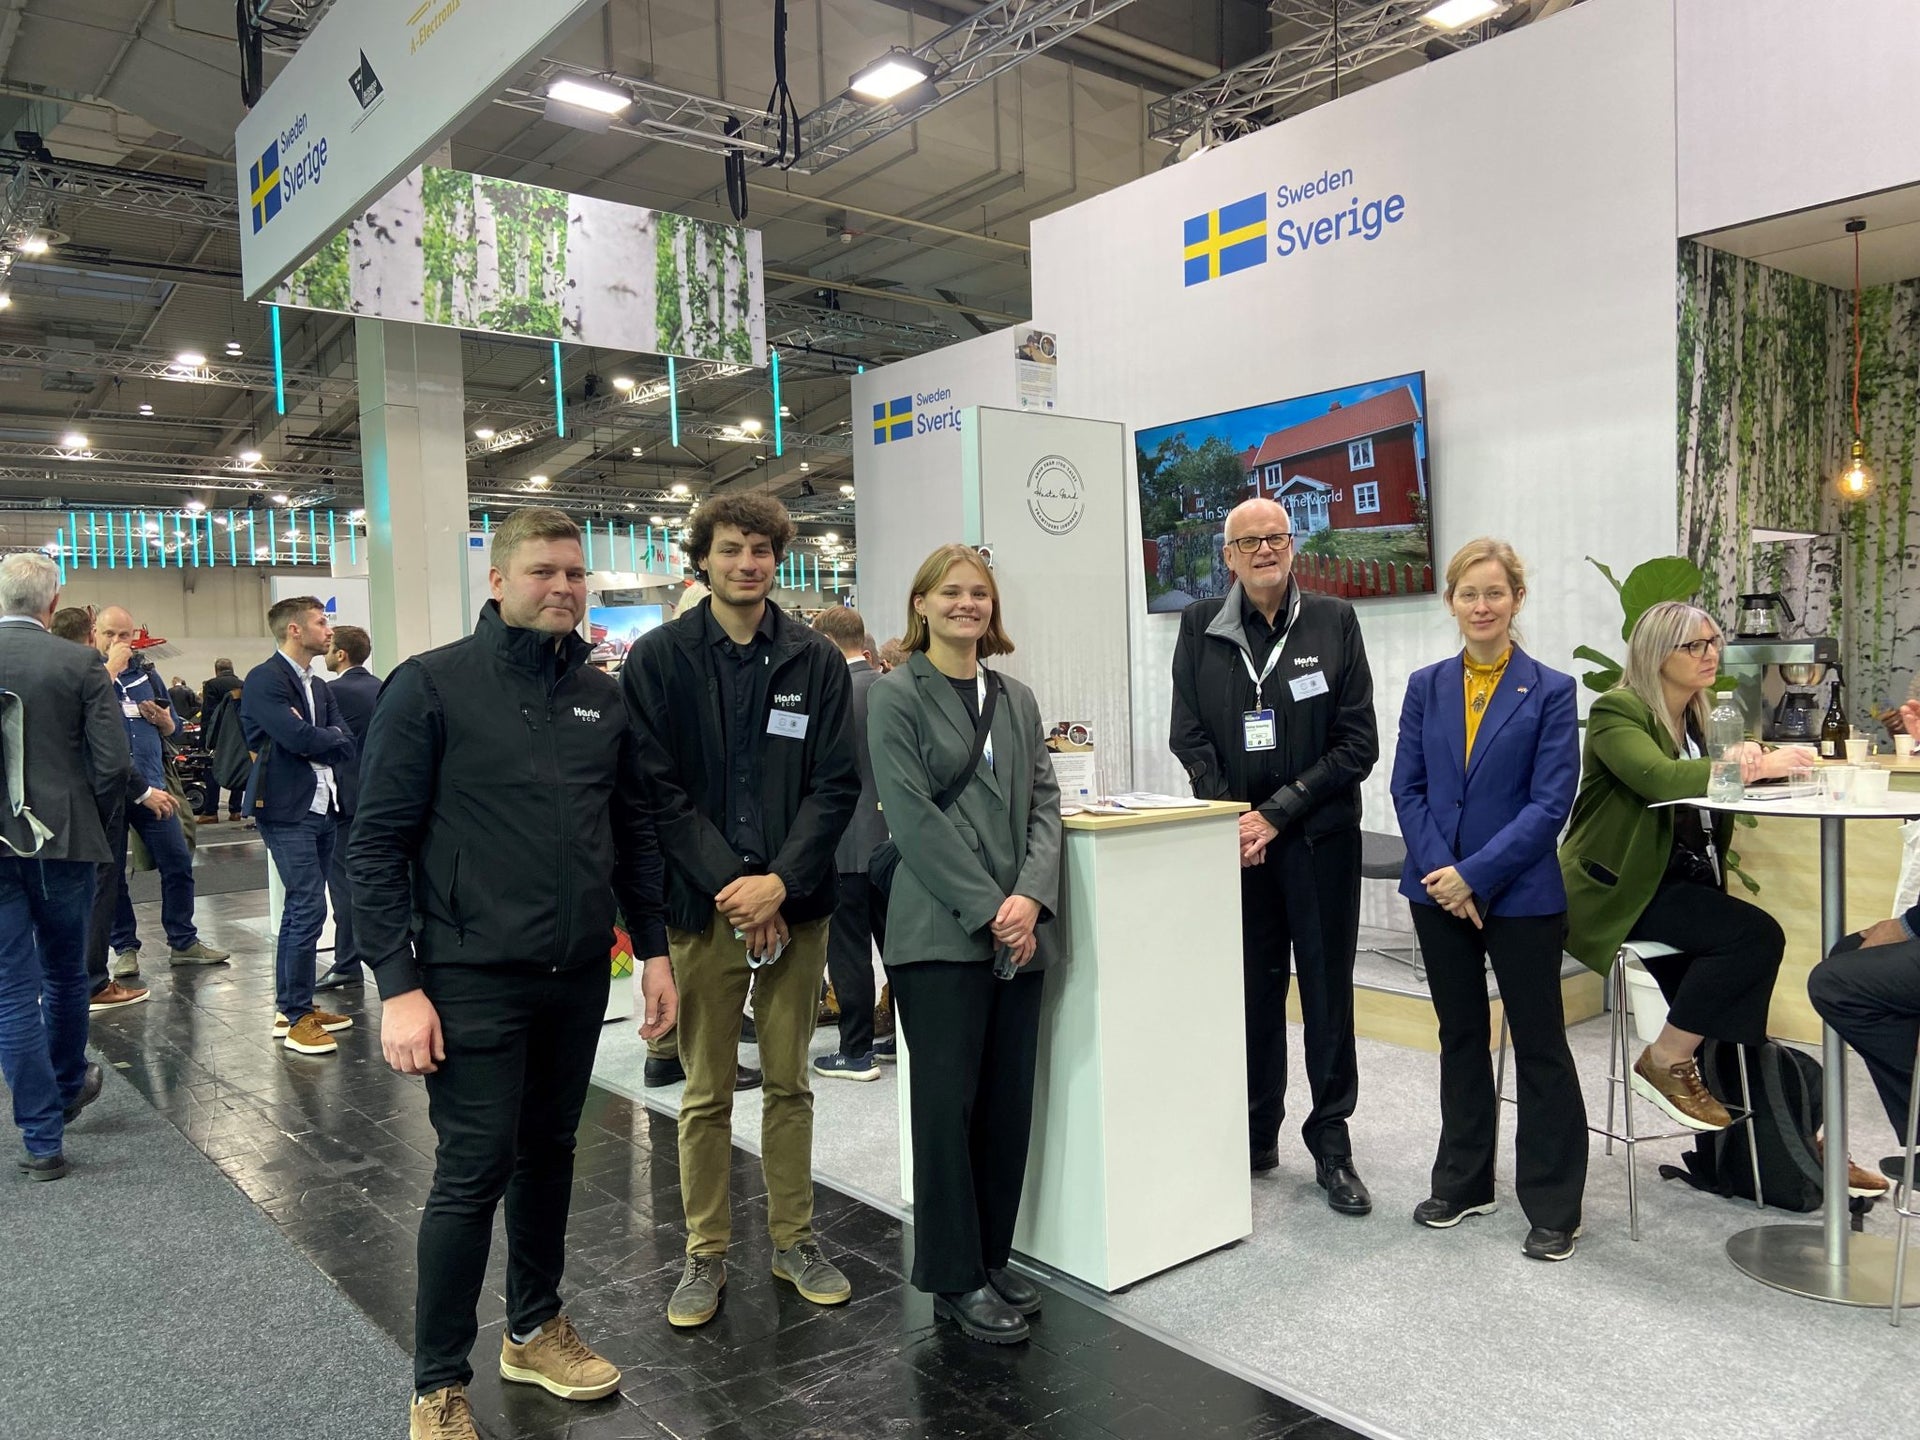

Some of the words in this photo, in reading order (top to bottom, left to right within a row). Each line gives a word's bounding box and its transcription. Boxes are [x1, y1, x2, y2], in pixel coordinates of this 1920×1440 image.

[280, 112, 308, 154] Sweden
[283, 137, 328, 203] Sverige
[1277, 168, 1353, 208] Sweden
[1276, 193, 1405, 257] Sverige
[916, 388, 951, 407] Sweden
[917, 405, 961, 435] Sverig
[1310, 488, 1343, 505] world
[1205, 508, 1215, 520] In
[1294, 655, 1319, 666] Hasta
[774, 693, 802, 703] Hasta
[573, 706, 600, 719] Hasta
